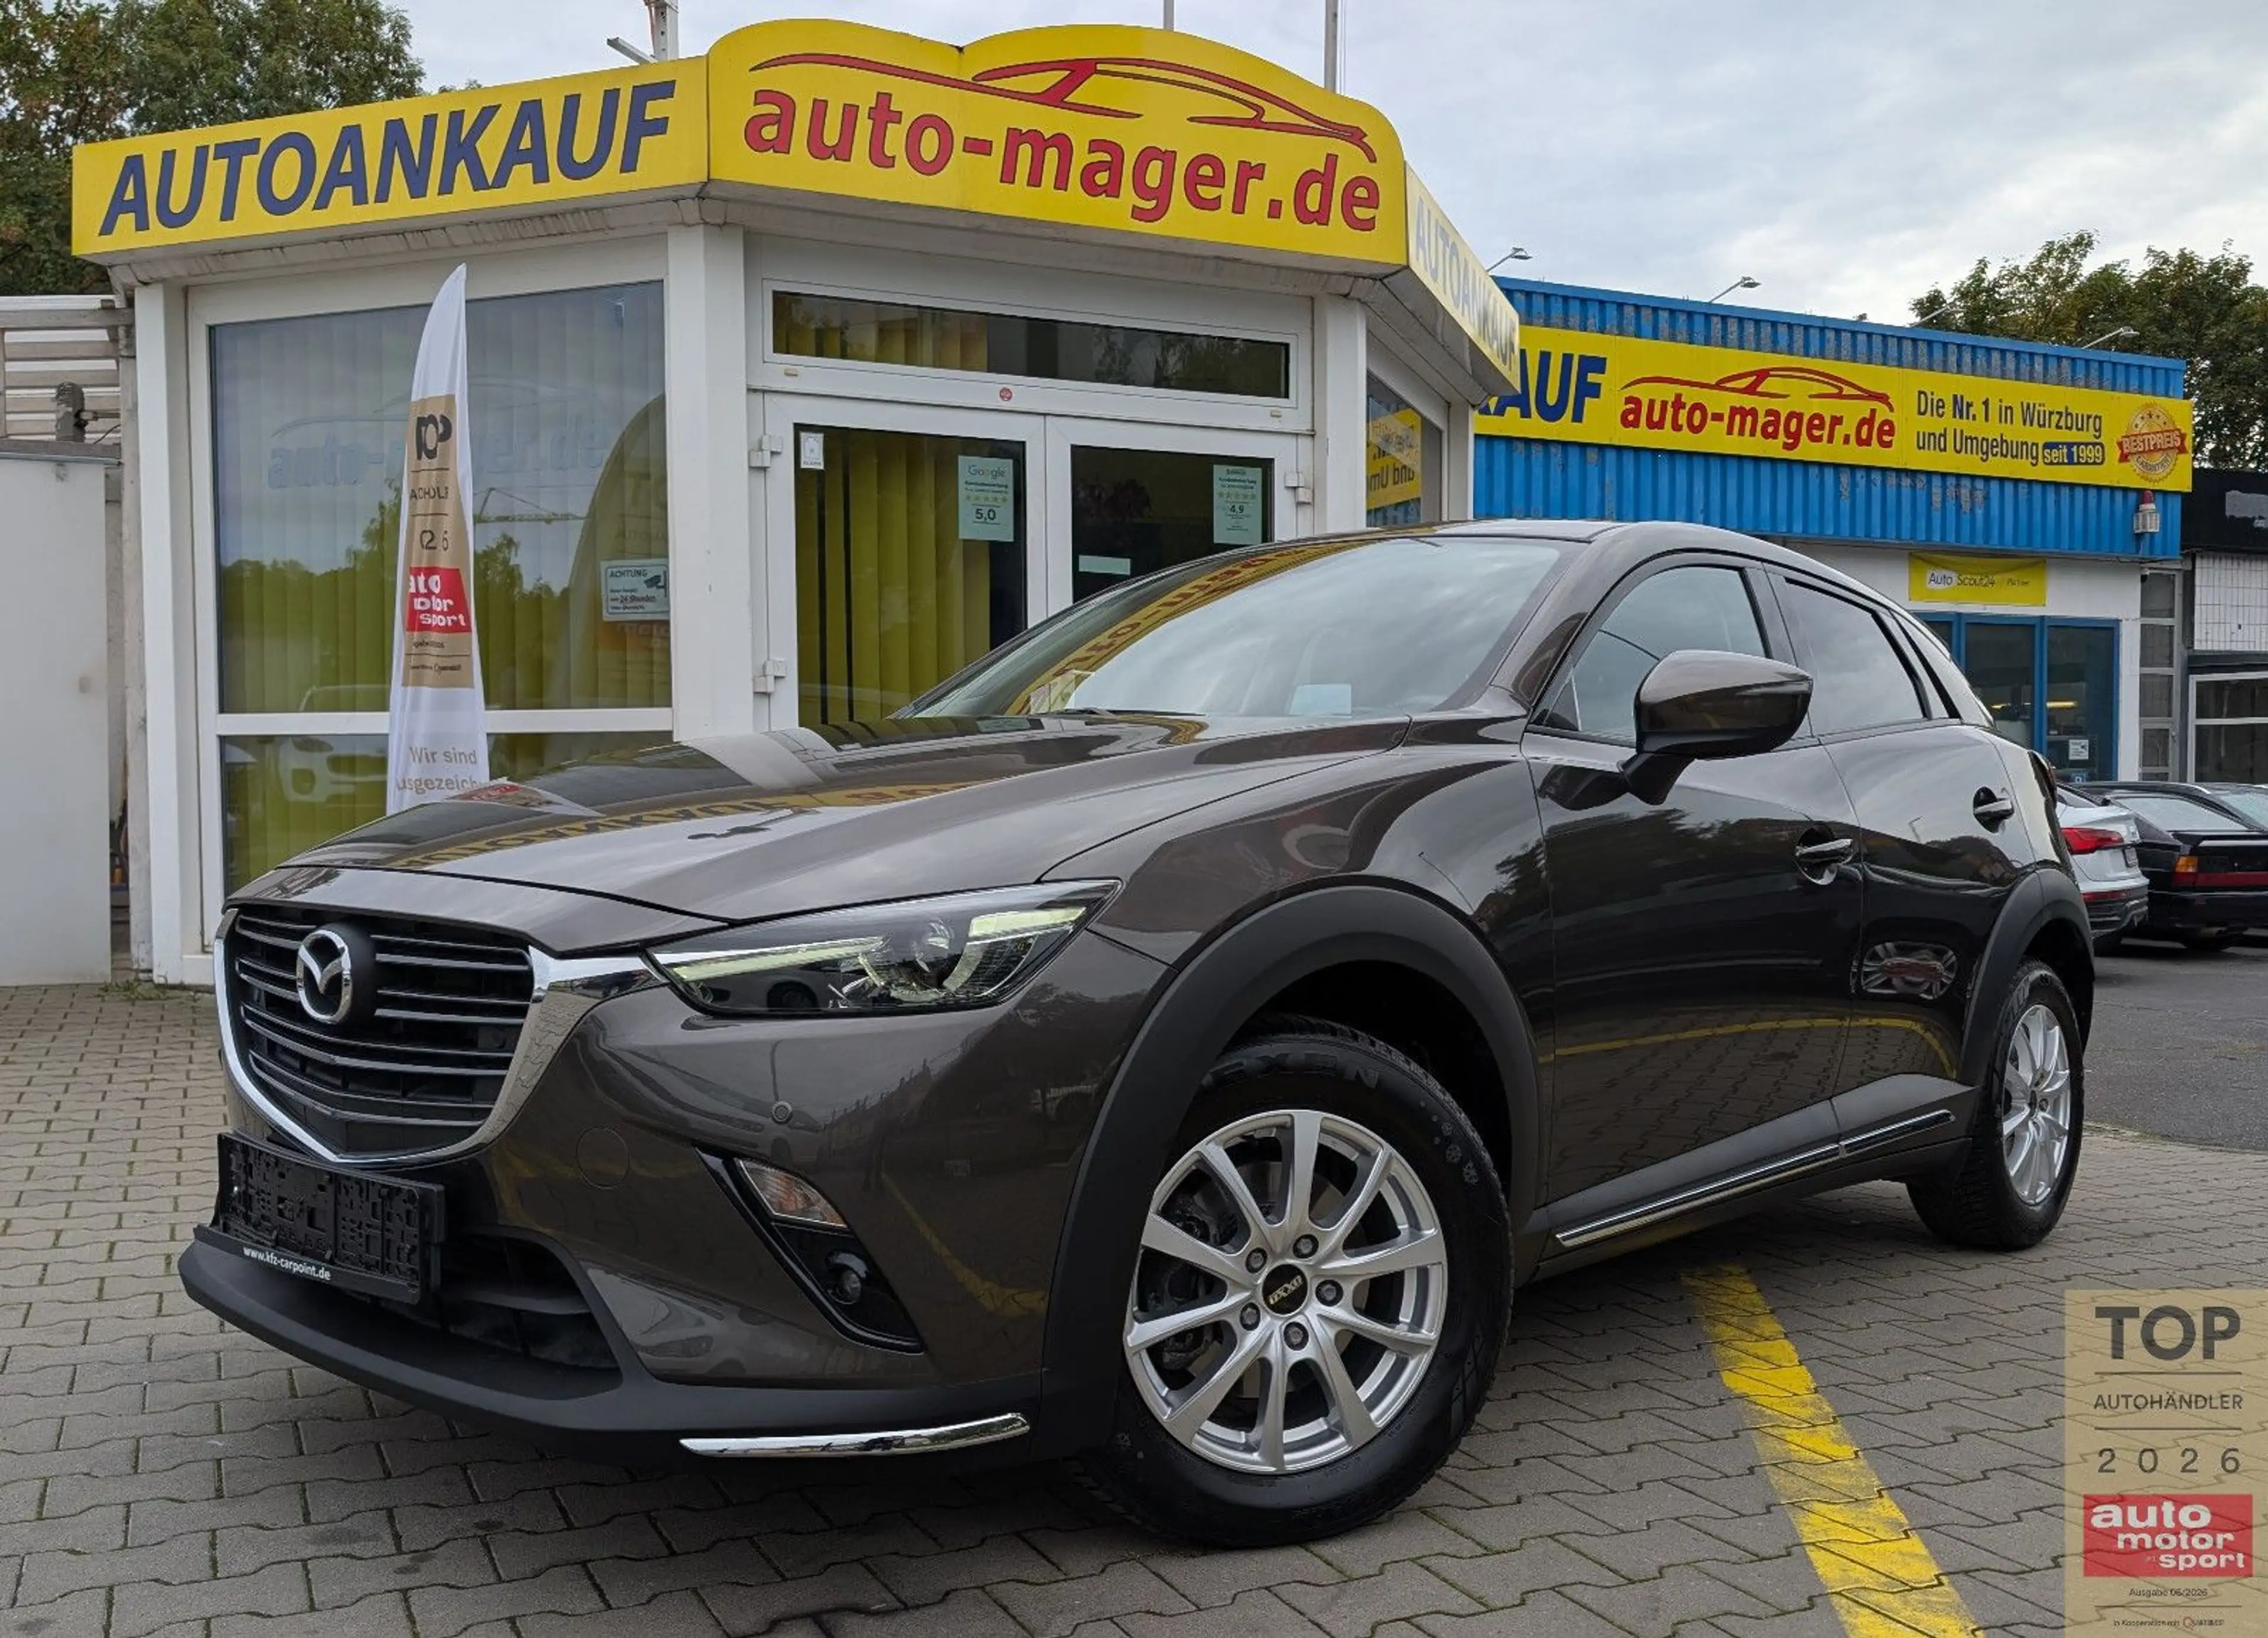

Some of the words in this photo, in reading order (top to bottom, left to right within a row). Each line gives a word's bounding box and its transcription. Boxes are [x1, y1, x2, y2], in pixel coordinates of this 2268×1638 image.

[99, 80, 676, 236] AUTOANKAUF
[744, 89, 1380, 231] auto-mager.de
[1620, 392, 1896, 451] auto-mager.de
[1917, 390, 1945, 417] Die
[1952, 394, 1976, 421] Nr.
[1982, 397, 1990, 422] 1
[1999, 399, 2013, 425] in
[2021, 401, 2103, 439] Würzburg
[1917, 428, 1946, 452] und
[1953, 429, 2039, 466] Umgebung
[2044, 444, 2067, 463] seit
[2071, 445, 2104, 464] 1999
[2122, 430, 2181, 453] BESTPREIS
[610, 569, 648, 578] ACHTUNG
[409, 747, 437, 764] Wir
[443, 747, 477, 765] sind
